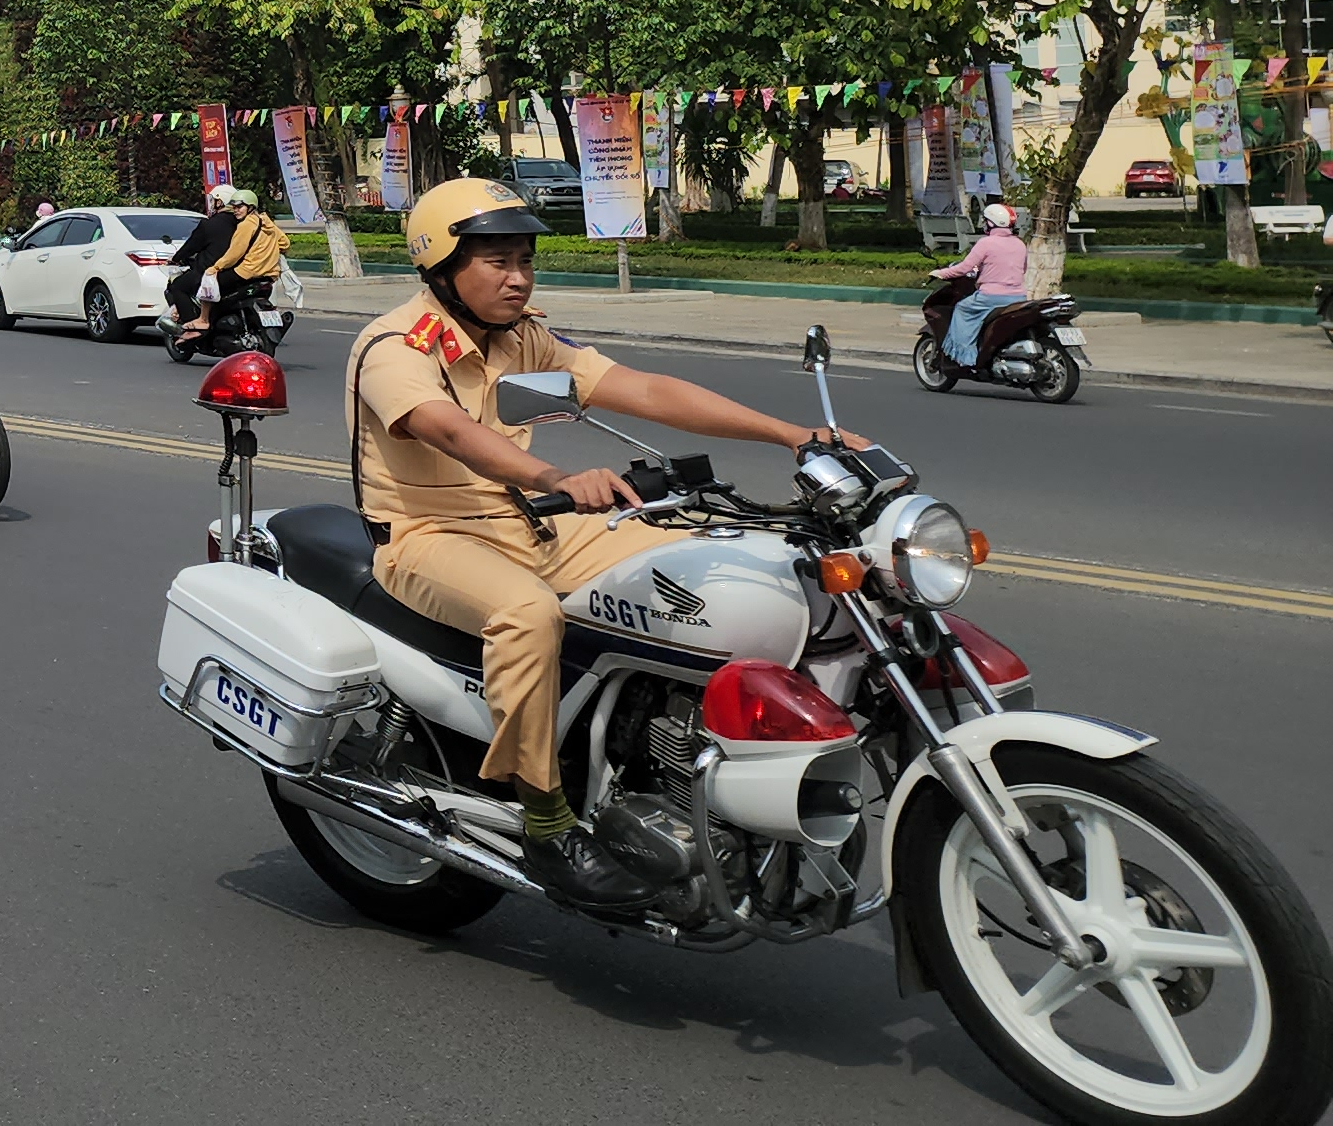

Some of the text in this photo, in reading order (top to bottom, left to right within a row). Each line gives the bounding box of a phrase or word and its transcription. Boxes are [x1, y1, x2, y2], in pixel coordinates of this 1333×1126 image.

[589, 589, 651, 633] CSGT
[649, 609, 712, 628] HONDA
[217, 675, 283, 737] CSGT
